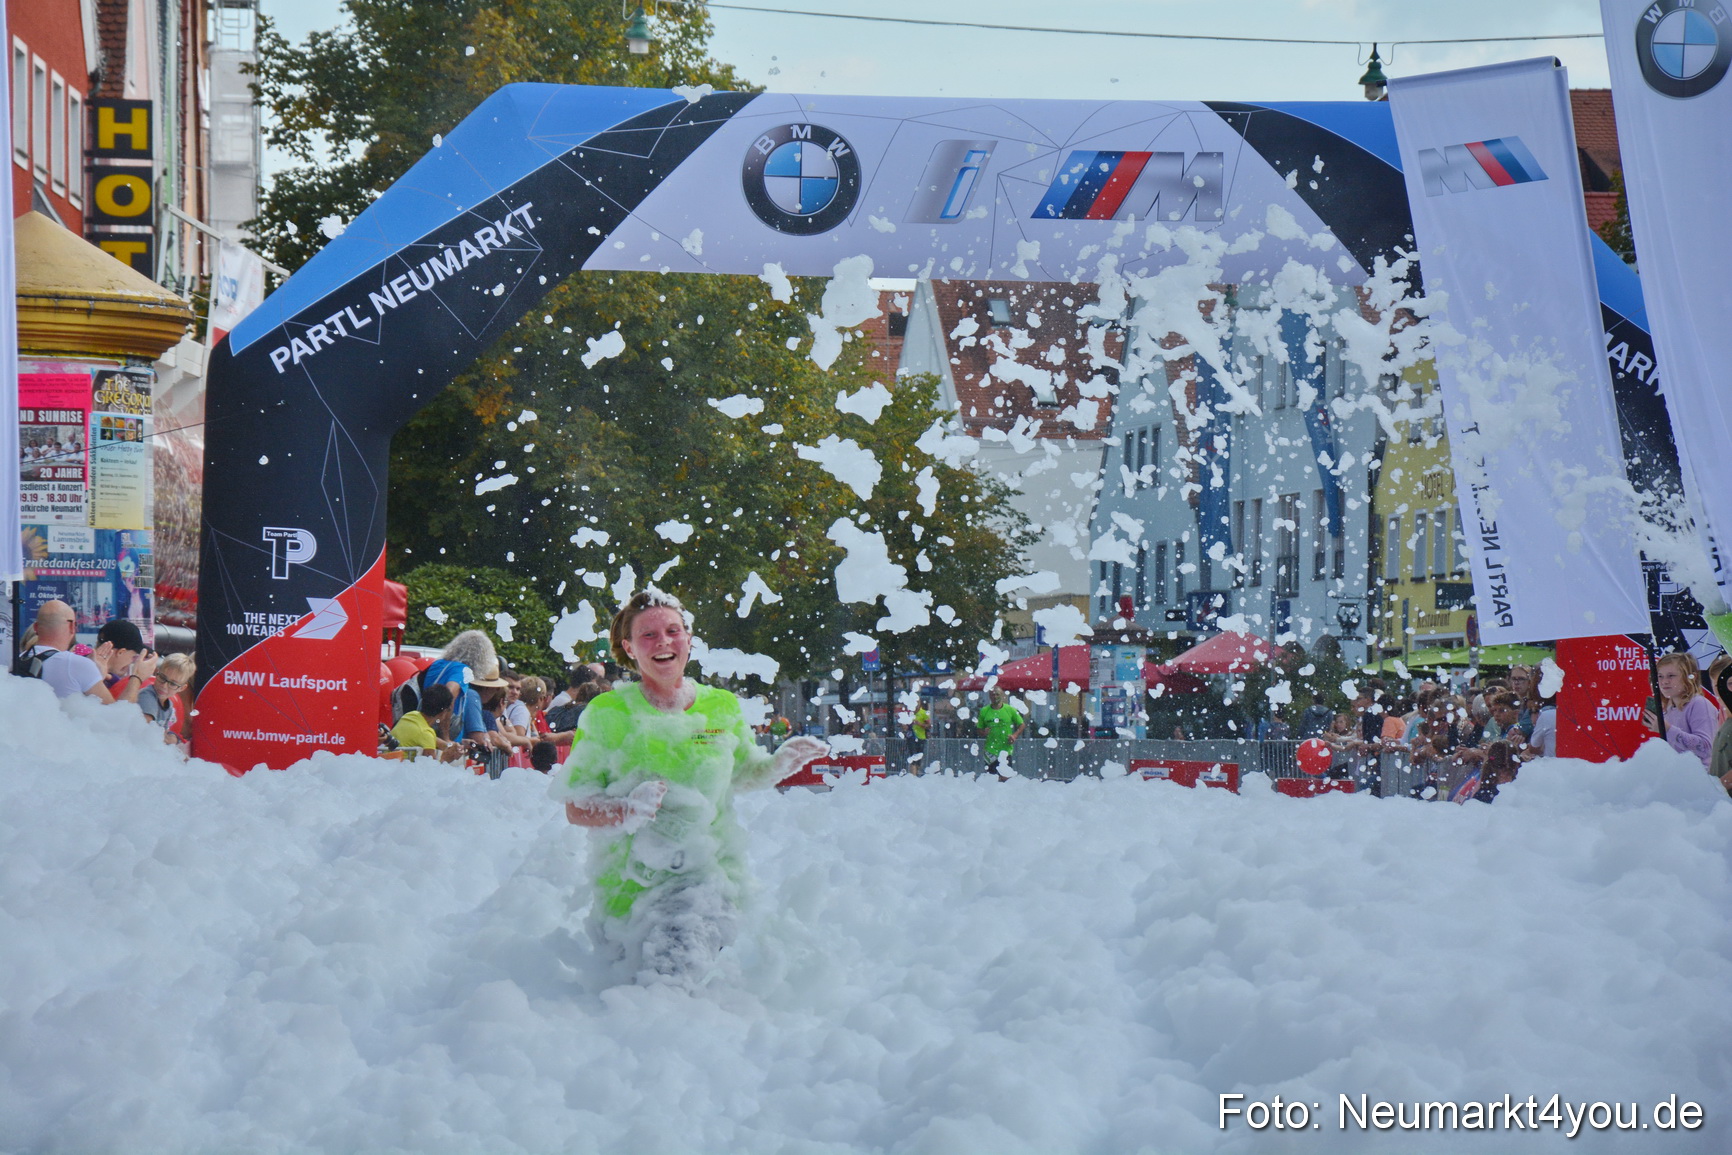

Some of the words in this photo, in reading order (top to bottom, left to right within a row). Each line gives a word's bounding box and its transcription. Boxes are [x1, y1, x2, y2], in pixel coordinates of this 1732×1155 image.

[754, 124, 851, 158] BMW
[269, 305, 372, 374] PARTL
[368, 201, 536, 316] NEUMARKT
[38, 411, 83, 423] SUNRISE
[40, 467, 52, 479] 20
[54, 468, 83, 480] JAHRE
[89, 466, 97, 487] andere
[58, 484, 83, 492] Konzert
[46, 494, 67, 503] 18.30
[69, 494, 82, 503] Uhr
[51, 505, 83, 513] Neumarkt
[96, 559, 117, 570] 2019
[244, 612, 266, 624] THE
[268, 613, 301, 626] NEXT
[226, 623, 245, 635] 100
[246, 624, 285, 638] YEARS
[1617, 647, 1640, 658] THE
[1597, 660, 1617, 671] 100
[1618, 660, 1652, 671] YEAR
[223, 671, 266, 686] BMW
[269, 672, 348, 693] Laufsport
[1597, 706, 1642, 722] BMW
[222, 727, 346, 745] www.bmw-partl.de
